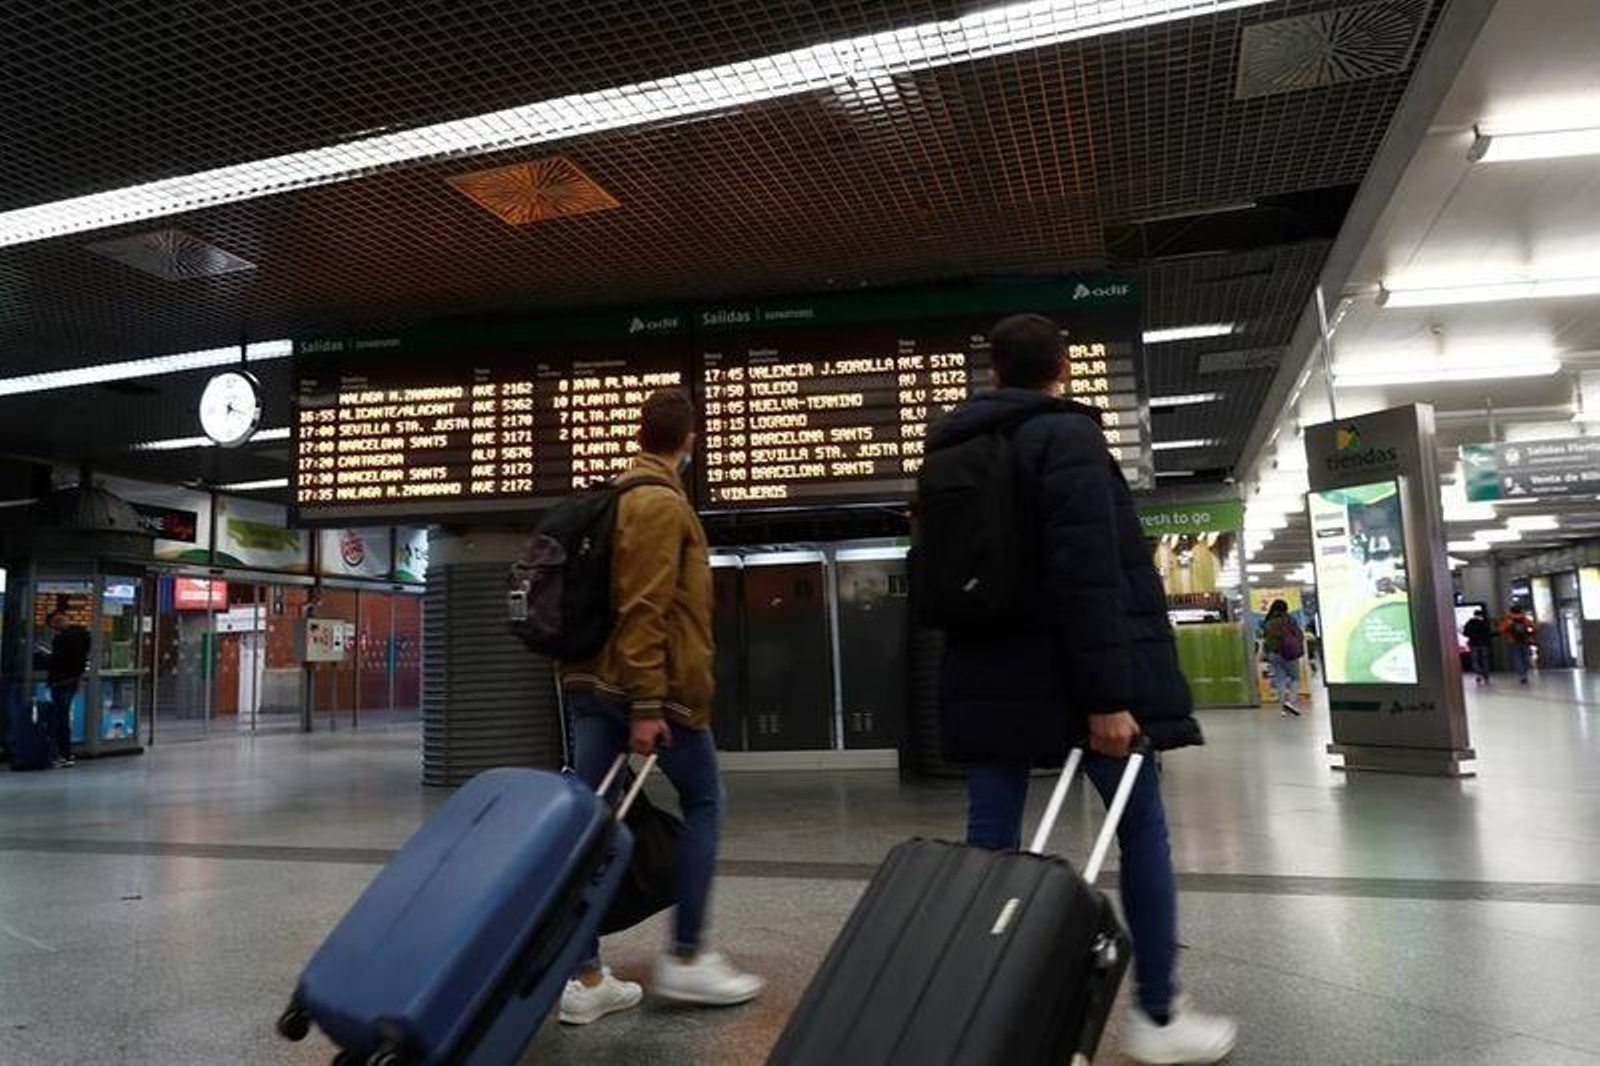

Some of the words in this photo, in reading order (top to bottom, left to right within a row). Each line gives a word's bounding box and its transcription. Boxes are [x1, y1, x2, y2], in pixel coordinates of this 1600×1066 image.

[703, 310, 751, 325] Salidas
[1069, 344, 1105, 358] BAJA
[705, 368, 744, 382] 17:45
[748, 363, 813, 379] VALENCIA
[821, 358, 894, 375] J.SOROLLA
[898, 356, 923, 369] AVE
[1069, 361, 1107, 375] BAJA
[705, 384, 744, 398] 17:50
[750, 381, 798, 395] TOLEDO
[1071, 378, 1108, 393] BAJA
[572, 393, 619, 406] PLANTA
[339, 422, 390, 436] SEVILLA
[396, 421, 424, 433] STA.
[432, 418, 469, 431] JUSTA
[706, 417, 745, 432] 18:15
[338, 437, 404, 452] BARCELONA
[410, 435, 447, 448] SANTS
[559, 429, 568, 440] 2
[707, 434, 745, 448] 18:30
[750, 429, 824, 447] BARCELONA
[830, 427, 872, 442] SANTS
[337, 453, 404, 468] CARTAGENA
[573, 442, 620, 455] PLANTA
[707, 451, 746, 465] 19:00
[751, 447, 808, 463] SEVILLA
[815, 446, 847, 459] STA.
[856, 443, 898, 457] JUSTA
[337, 469, 404, 484] BARCELONA
[409, 467, 447, 480] SANTS
[708, 468, 746, 482] 19:00
[751, 464, 825, 480] BARCELONA
[831, 461, 874, 475] SANTS
[721, 485, 787, 500] VIAJEROS
[1138, 512, 1171, 526] resh
[1173, 511, 1189, 525] to
[1191, 511, 1212, 526] go
